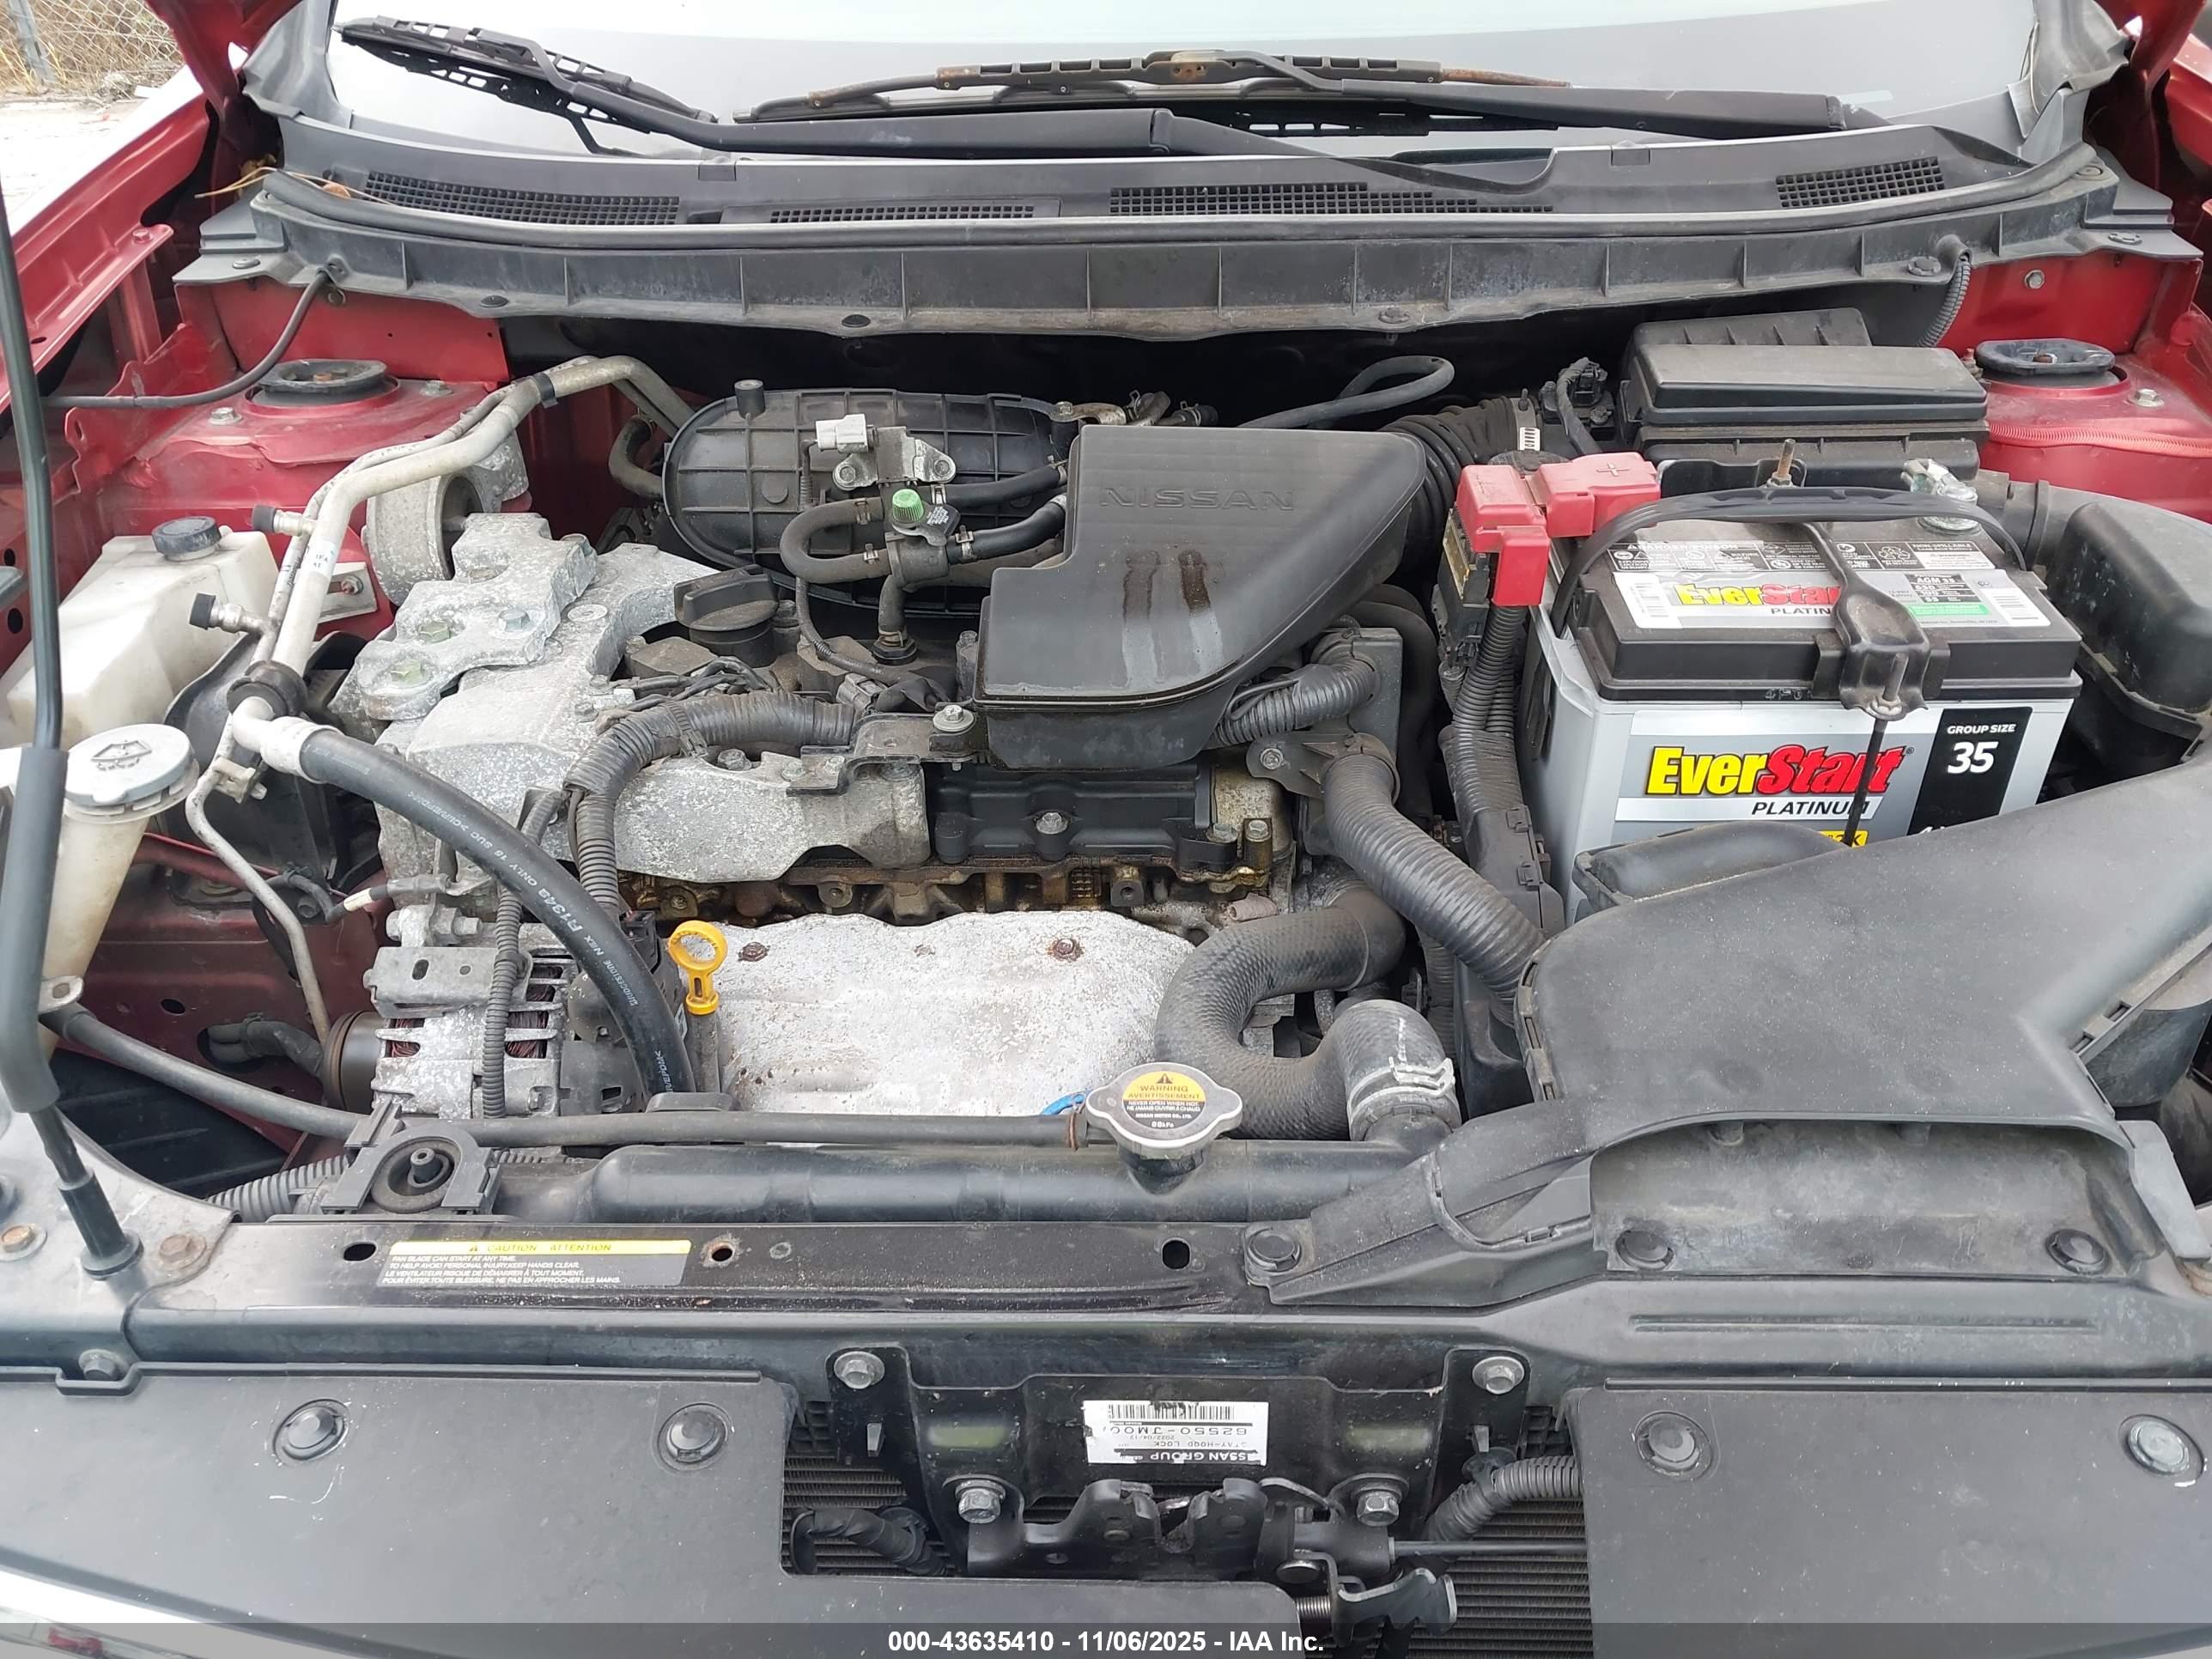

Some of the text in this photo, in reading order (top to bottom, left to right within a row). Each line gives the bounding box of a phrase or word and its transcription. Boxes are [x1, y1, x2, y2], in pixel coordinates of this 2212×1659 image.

[1100, 487, 1296, 510] NISSAN
[1674, 583, 1841, 605] EverStar
[1947, 724, 2016, 734] GROUP SIZE
[1948, 741, 1999, 774] 35
[1645, 744, 1906, 796] EverStart
[509, 864, 538, 886] ONLY
[538, 888, 583, 932] R134a
[1150, 1451, 1205, 1461] GROUP
